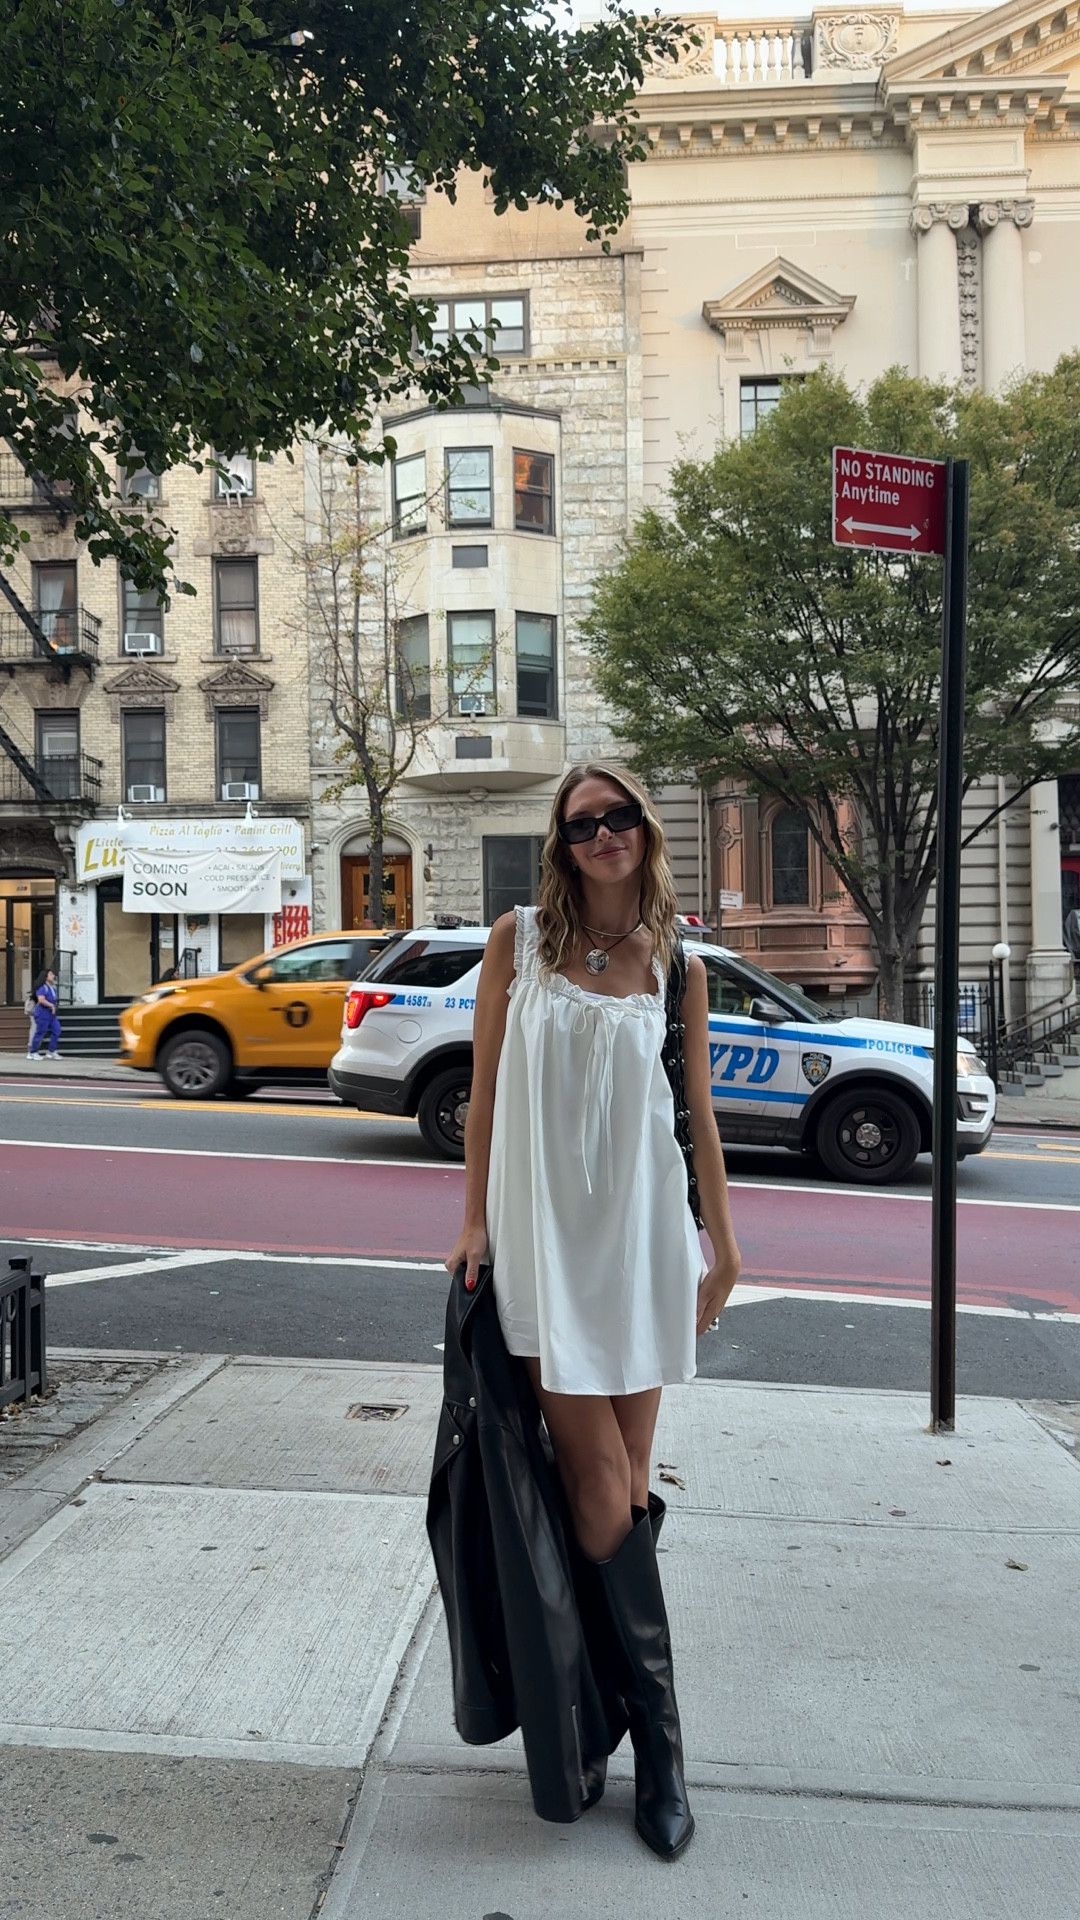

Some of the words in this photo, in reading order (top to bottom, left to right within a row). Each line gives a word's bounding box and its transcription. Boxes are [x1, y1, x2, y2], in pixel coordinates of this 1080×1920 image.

[841, 459, 861, 478] NO
[865, 462, 934, 488] STANDING
[841, 481, 900, 505] Anytime
[149, 825, 175, 836] Pizza
[178, 825, 190, 836] Al
[193, 825, 222, 838] Taglio
[269, 824, 292, 835] Grill
[95, 837, 124, 847] Little
[133, 863, 188, 875] COMING
[236, 863, 265, 871] SALADS
[132, 882, 187, 896] SOON
[444, 997, 456, 1008] 23
[459, 998, 476, 1009] PCT
[869, 1039, 912, 1055] POLICE
[709, 1043, 779, 1084] YPD
